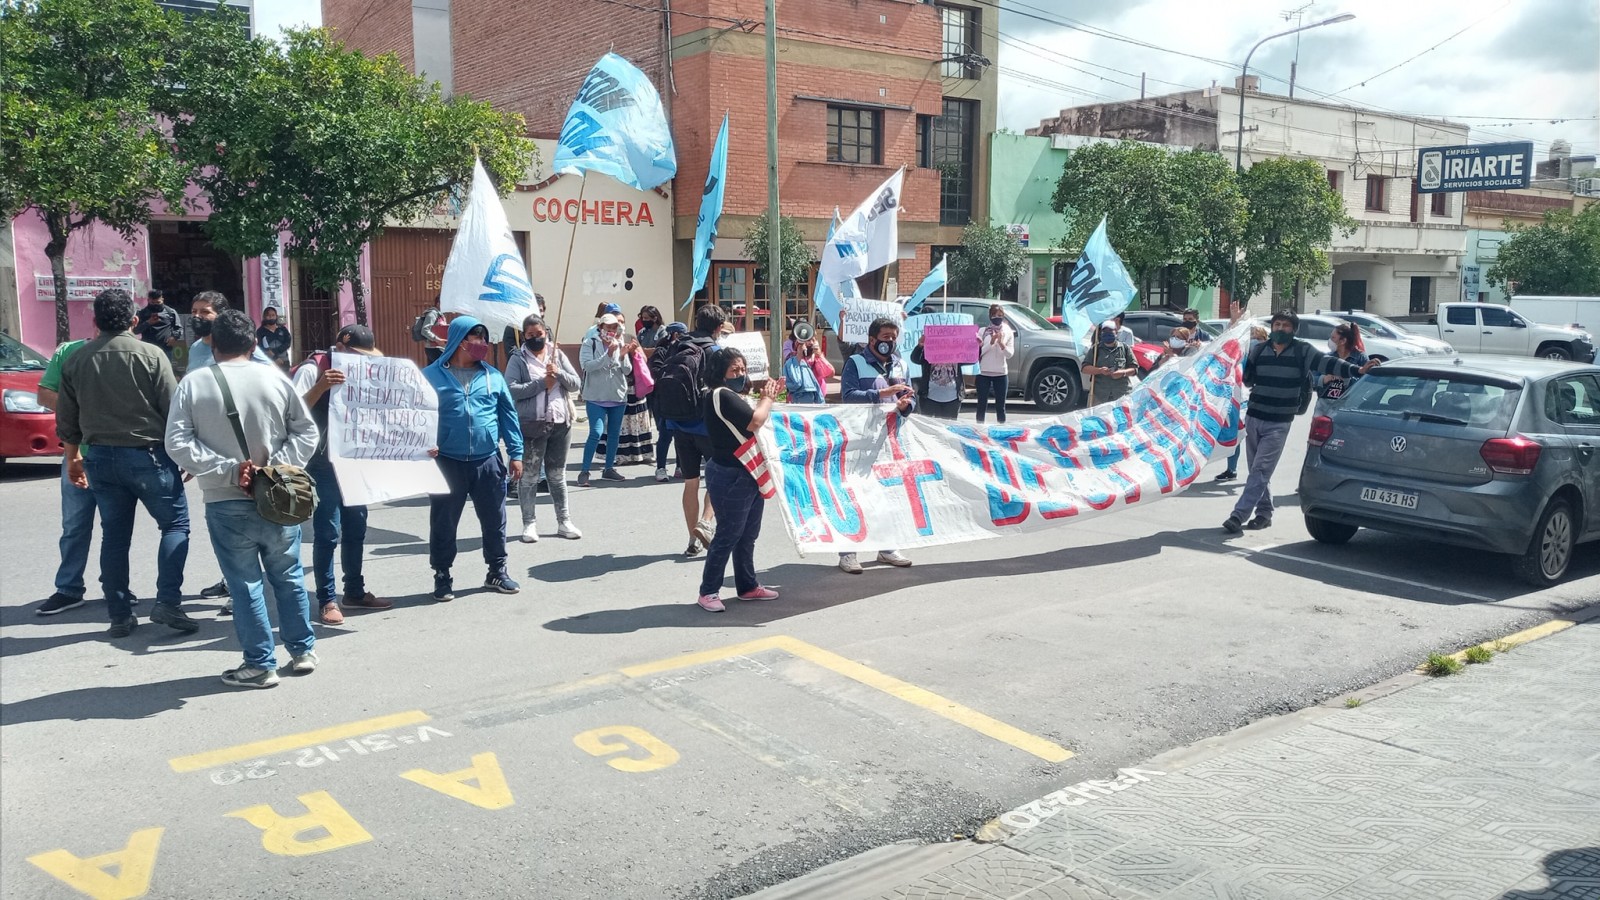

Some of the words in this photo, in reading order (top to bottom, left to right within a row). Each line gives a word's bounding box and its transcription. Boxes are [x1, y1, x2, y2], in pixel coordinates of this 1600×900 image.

[1445, 147, 1480, 156] EMPRESA
[1444, 153, 1524, 180] IRIARTE
[1443, 181, 1482, 189] SERVICIOS
[1484, 178, 1522, 187] SOCIALES
[532, 196, 654, 227] COCHERA
[1363, 488, 1376, 500] AD
[1379, 490, 1398, 505] 431
[1400, 495, 1416, 507] HS
